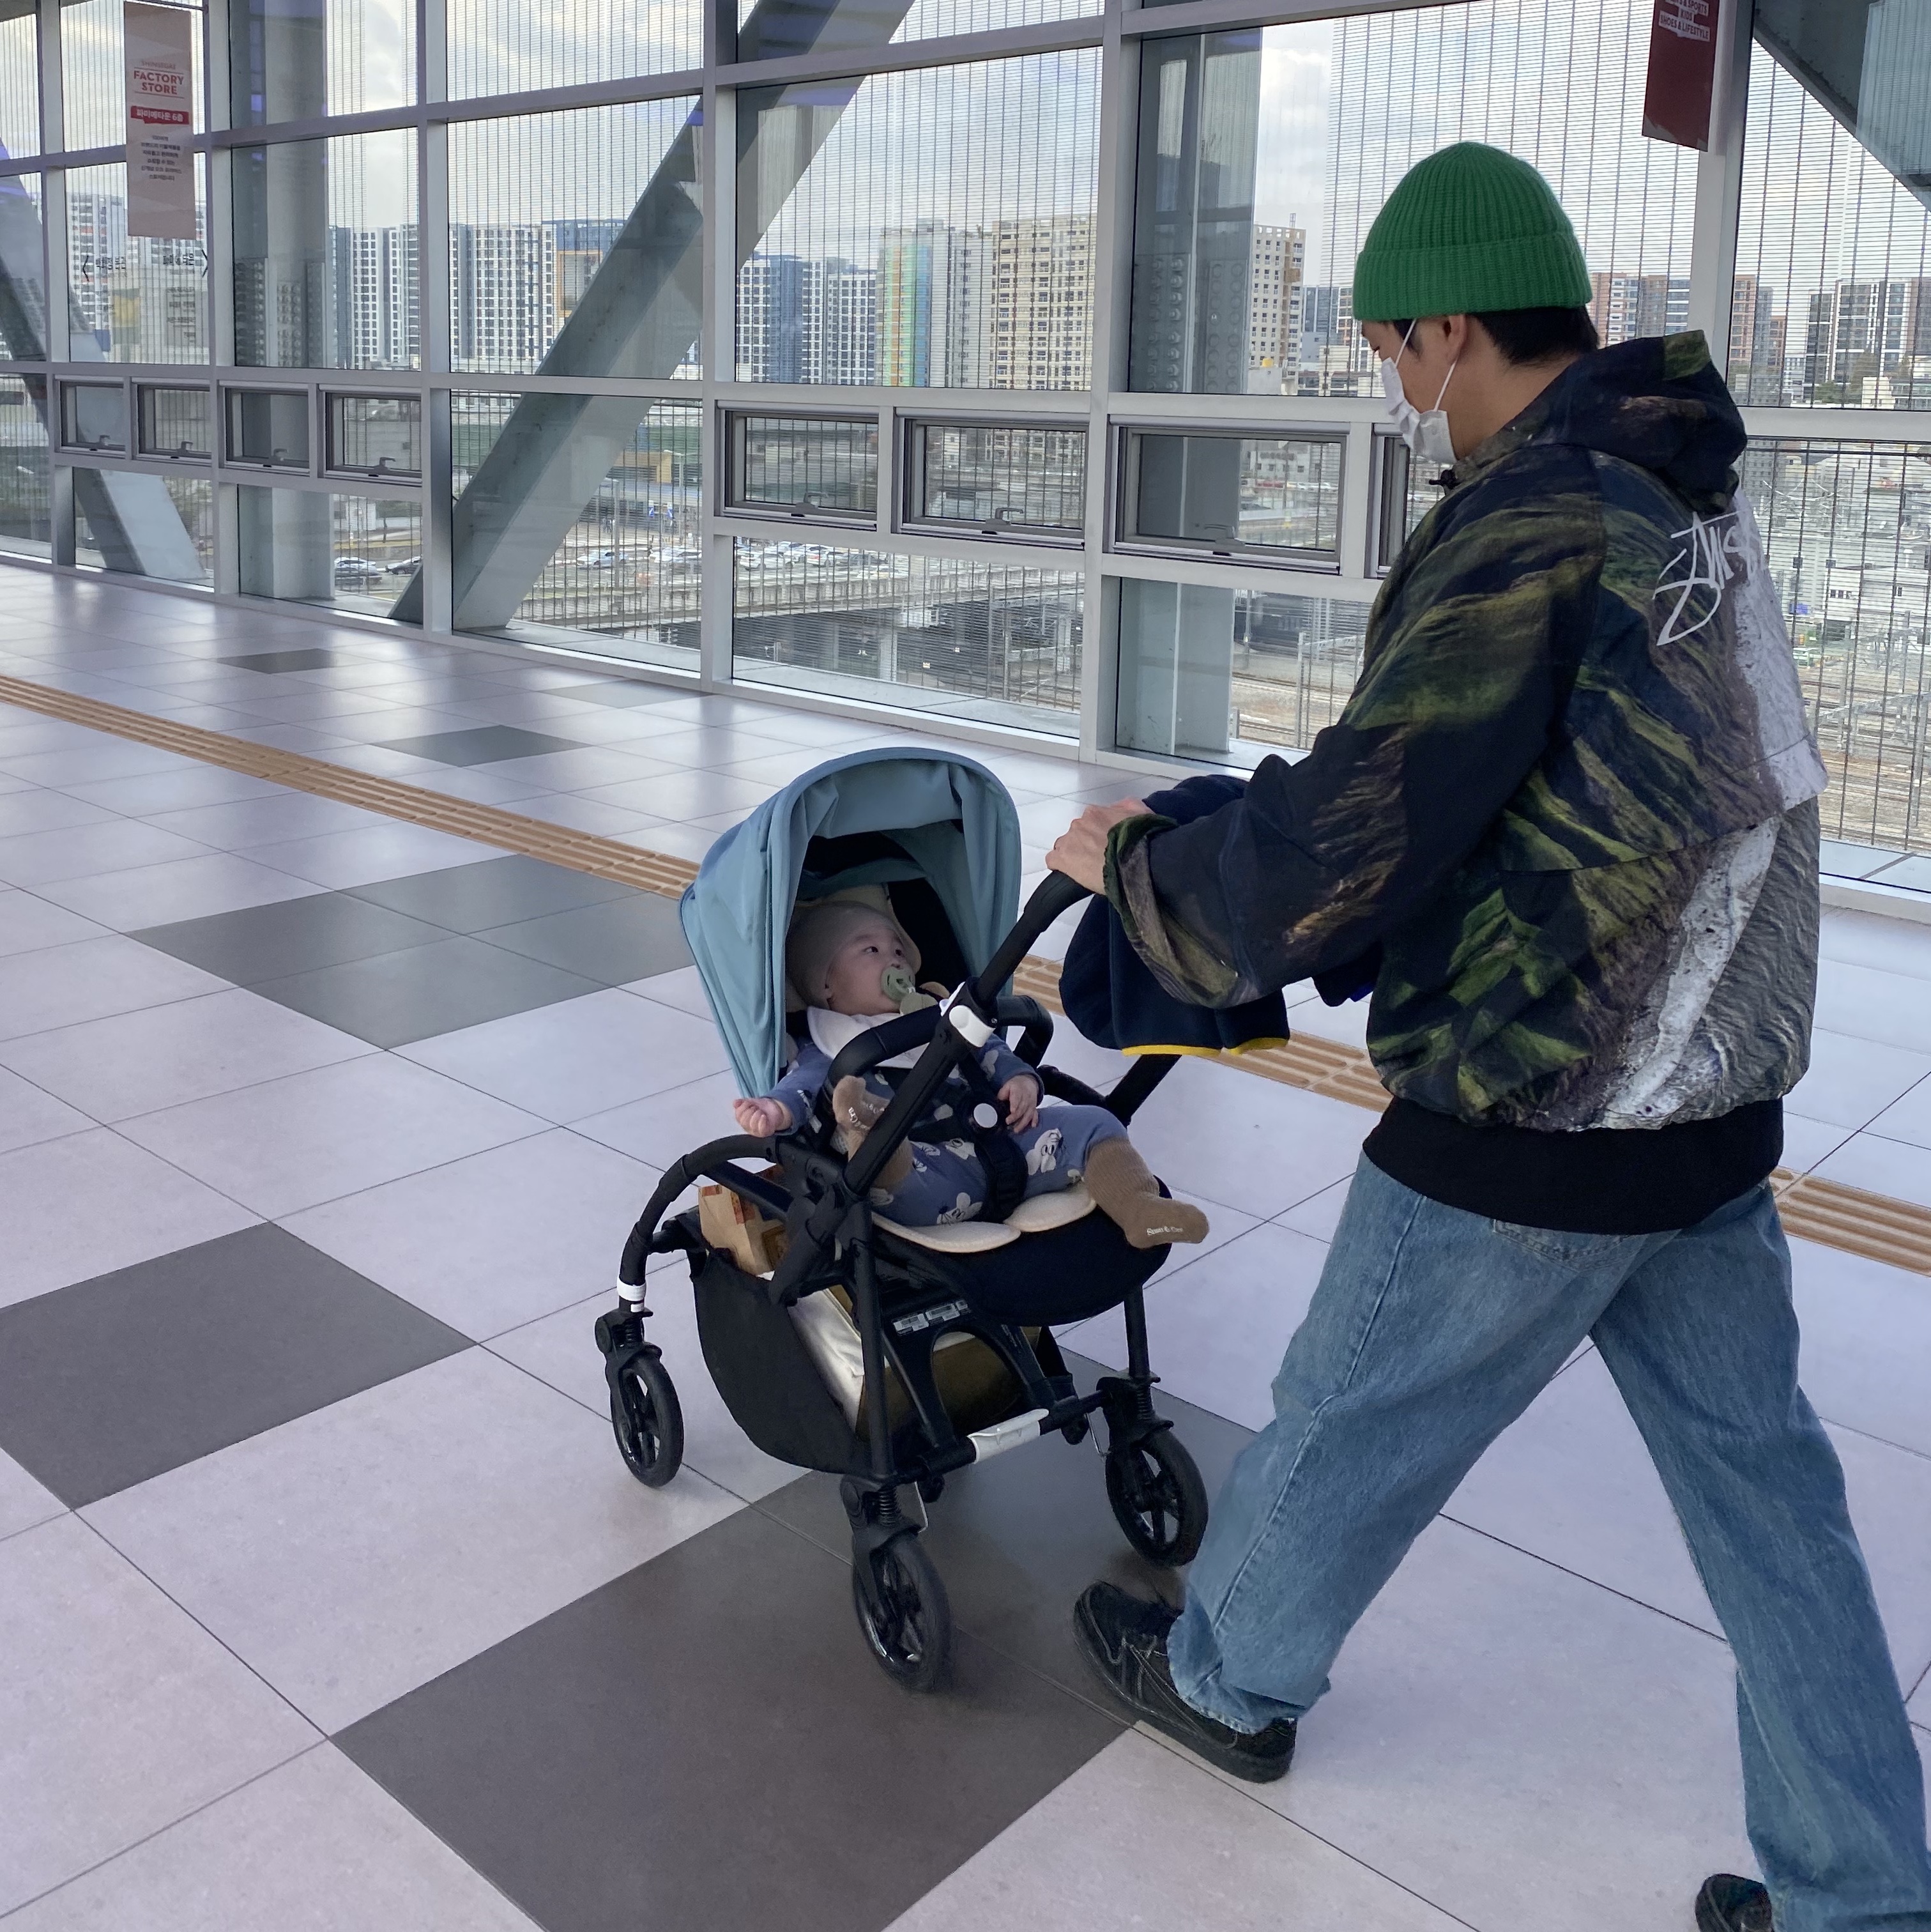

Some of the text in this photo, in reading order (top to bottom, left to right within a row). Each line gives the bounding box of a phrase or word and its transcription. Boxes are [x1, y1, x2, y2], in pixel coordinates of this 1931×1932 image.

[1688, 0, 1707, 13] SPORTS
[1681, 9, 1693, 21] KIDS
[1661, 14, 1709, 40] SHOES & LIFESTYLE
[134, 70, 183, 85] FACTORY
[142, 82, 178, 95] STORE
